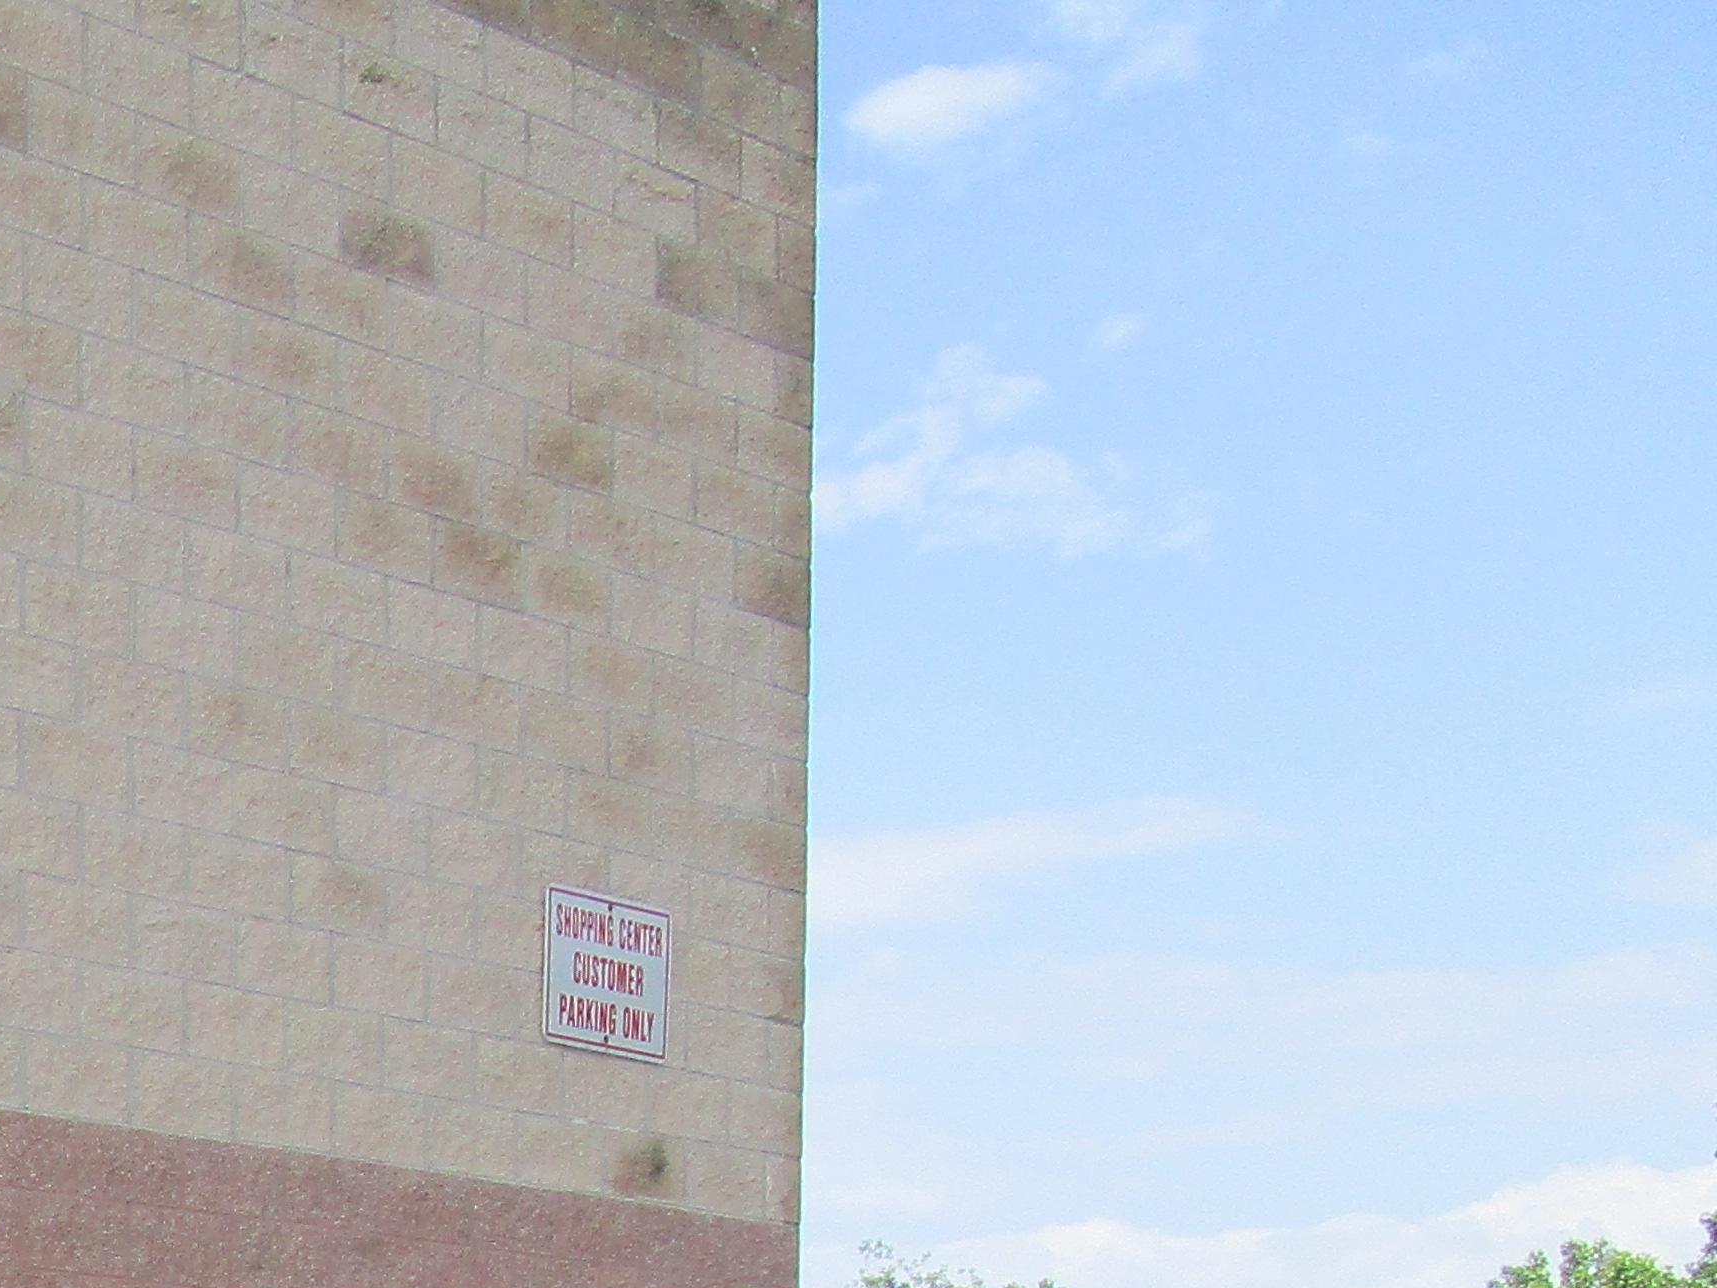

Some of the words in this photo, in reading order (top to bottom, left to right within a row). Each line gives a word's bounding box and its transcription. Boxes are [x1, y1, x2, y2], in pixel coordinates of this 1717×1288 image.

[555, 902, 614, 947] SHOPPING
[618, 918, 663, 958] CENTER
[572, 951, 644, 997] CUSTOMER
[559, 993, 617, 1035] PARKING
[622, 1007, 655, 1043] ONLY
